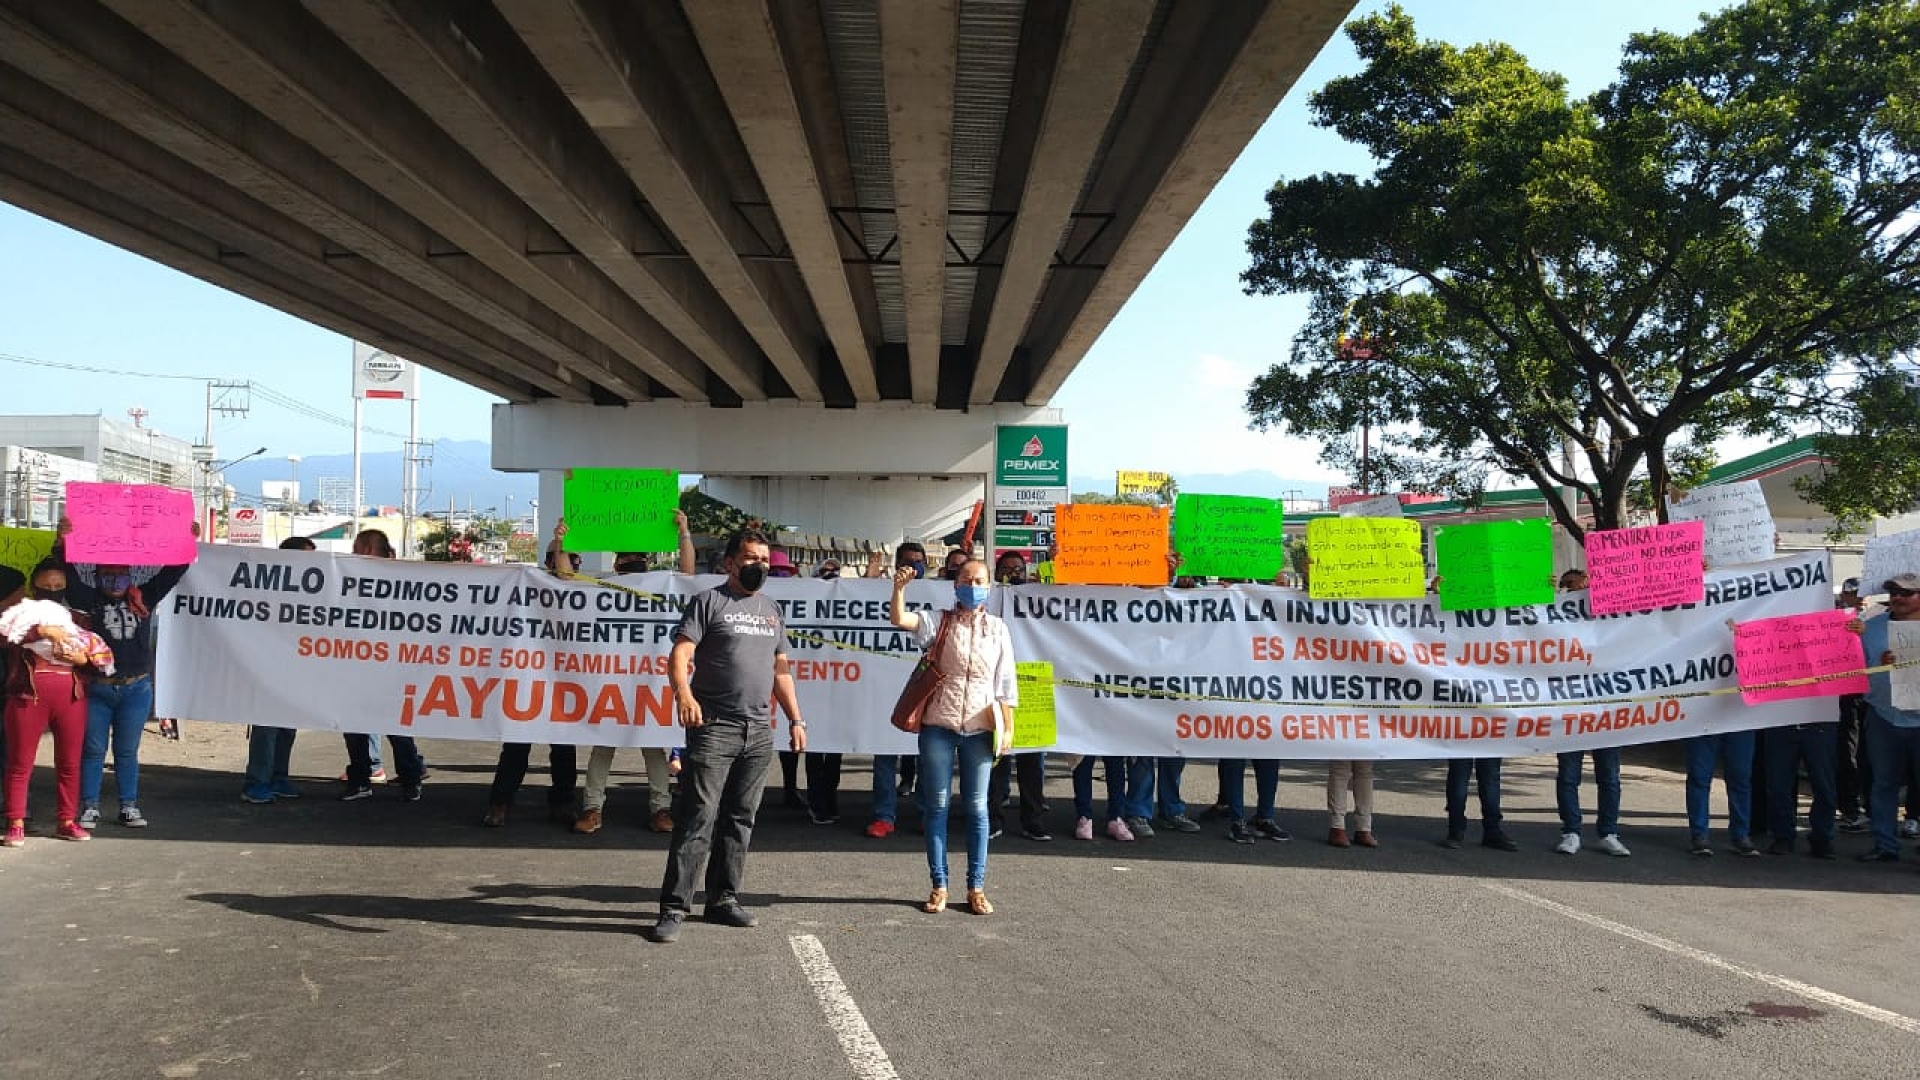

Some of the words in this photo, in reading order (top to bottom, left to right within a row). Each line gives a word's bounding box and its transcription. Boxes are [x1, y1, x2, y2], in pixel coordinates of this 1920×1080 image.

[1003, 459, 1060, 471] PEMEX
[1641, 547, 1657, 558] NO
[230, 562, 325, 595] AMLO
[341, 576, 458, 604] PEDIMOS
[468, 584, 501, 605] TU
[506, 586, 587, 610] APOYO
[596, 591, 688, 613] CUERN
[815, 599, 934, 620] NECESTA
[1013, 595, 1119, 623] LUCHAR
[1127, 598, 1237, 623] CONTRA
[1244, 599, 1278, 622] LA
[1286, 599, 1446, 633] INJUSTICIA,
[1455, 606, 1497, 628] NO
[1505, 602, 1539, 626] ES
[1704, 560, 1827, 607] REBELDIA
[173, 594, 271, 622] FUIMOS
[278, 603, 442, 634] DESPEDIDOS
[450, 614, 645, 643] INJUSTAMENTE
[298, 636, 390, 663] SOMOS
[397, 643, 451, 666] MAS
[459, 646, 493, 668] DE
[499, 649, 546, 671] 500
[554, 652, 669, 676] FAMILIAS
[1252, 635, 1286, 661] ES
[1292, 636, 1408, 666] ASUNTO
[1412, 641, 1448, 667] DE
[1455, 637, 1593, 667] JUSTICIA,
[1093, 672, 1283, 701] NECESITAMOS
[1291, 675, 1424, 701] NUESTRO
[1433, 676, 1540, 704] EMPLEO
[1547, 653, 1738, 701] REINSTALANO
[1175, 713, 1273, 741] SOMOS
[1281, 714, 1371, 741] GENTE
[1378, 714, 1508, 740] HUMILDE
[1515, 716, 1553, 738] DE
[1561, 699, 1686, 736] TRABAJO.
